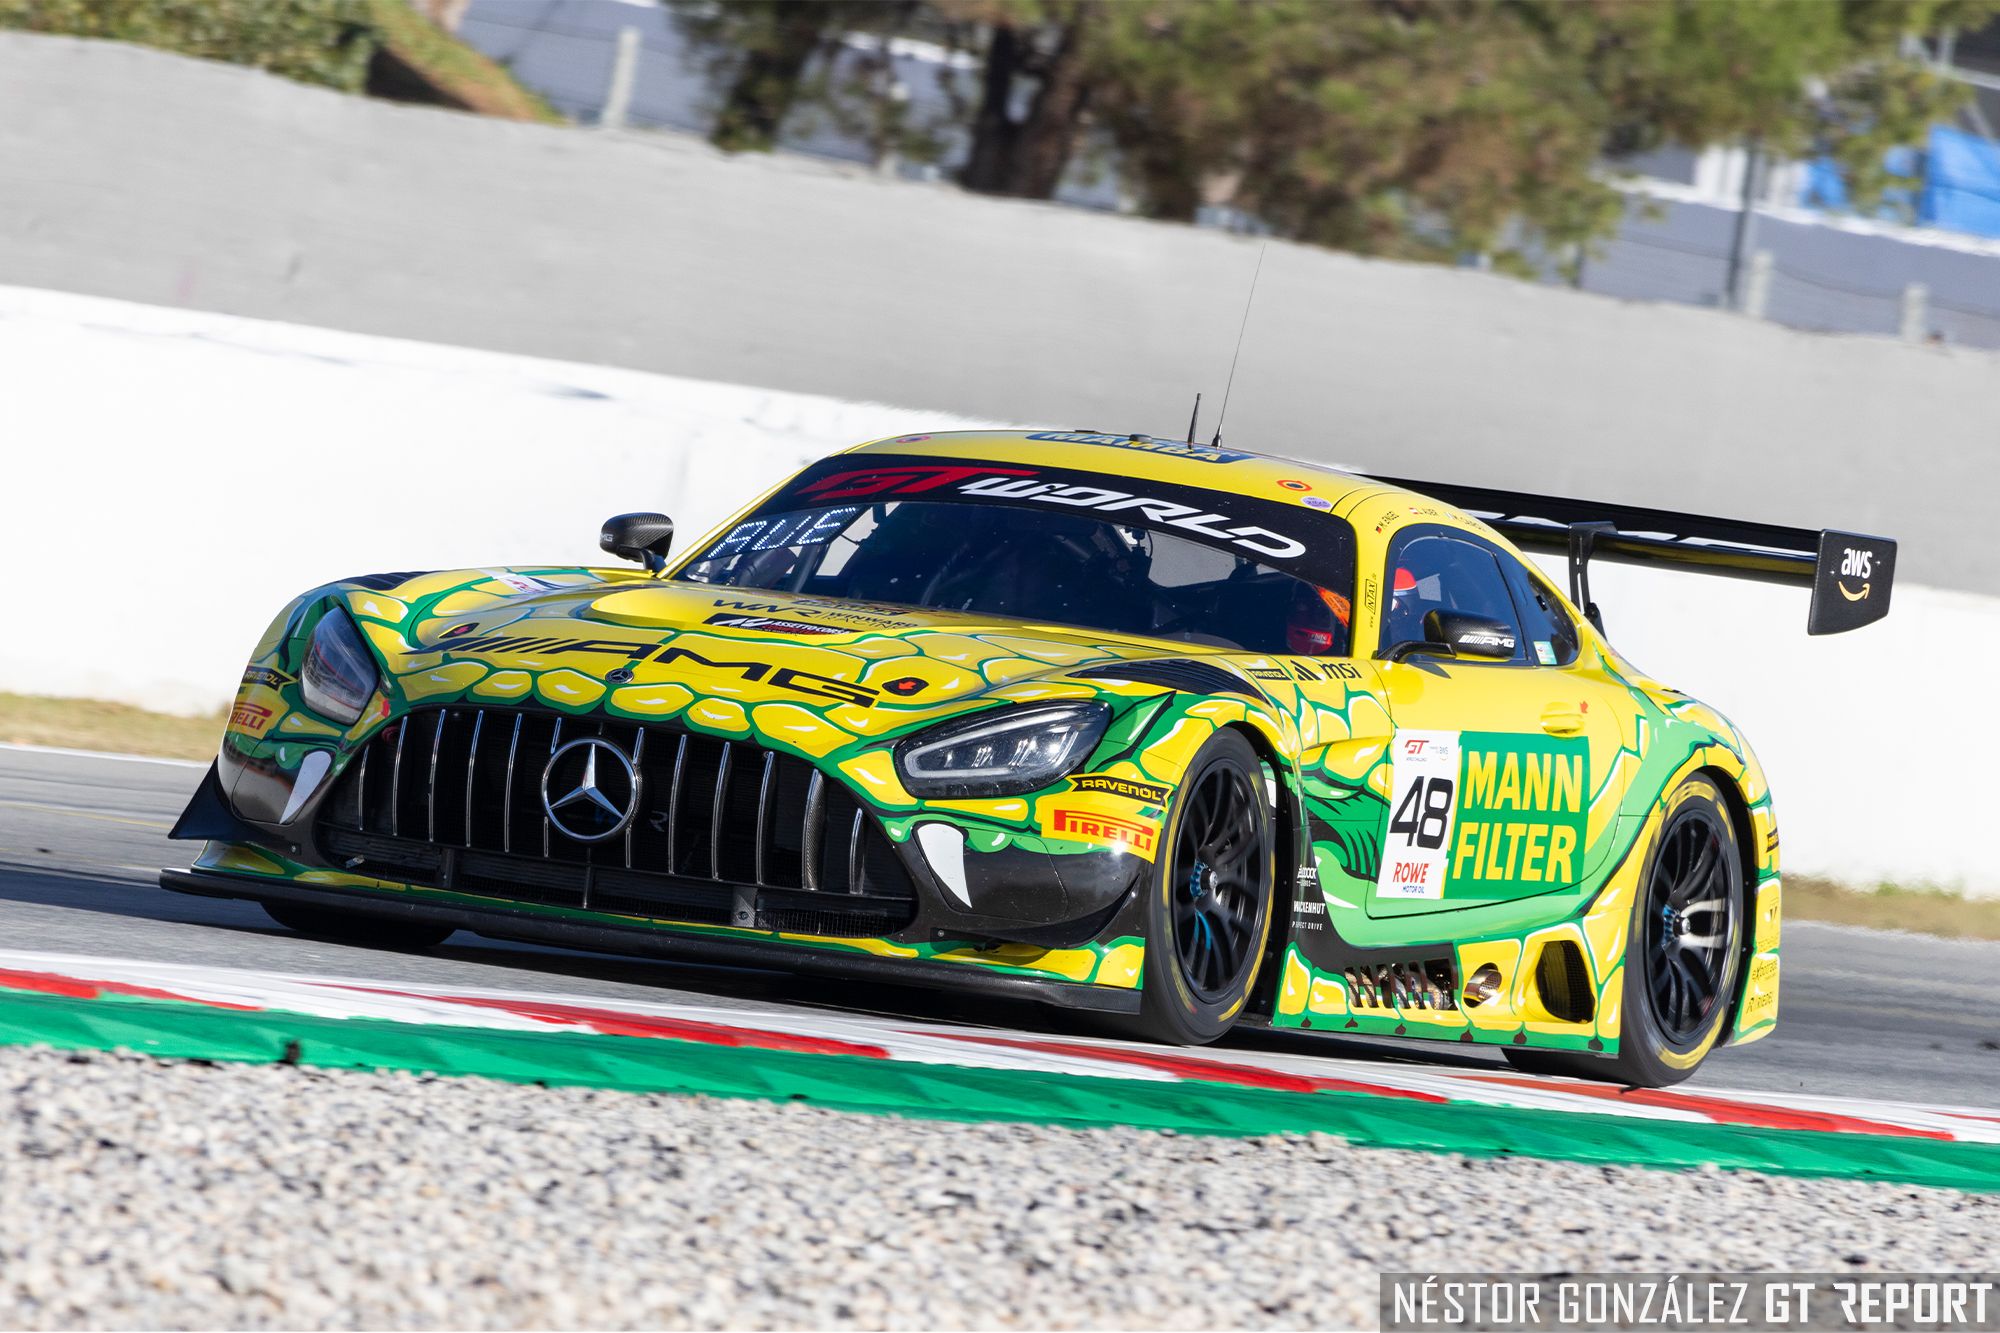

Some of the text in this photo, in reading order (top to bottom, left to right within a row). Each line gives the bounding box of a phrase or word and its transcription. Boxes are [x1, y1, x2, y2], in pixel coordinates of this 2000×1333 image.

[798, 465, 1307, 559] GT WORLD
[1840, 547, 1873, 579] aws
[828, 611, 920, 628] WINWARD
[1478, 636, 1515, 648] AMG
[535, 638, 882, 709] AMG
[1319, 663, 1362, 679] msi
[1463, 750, 1583, 813] MANN
[1053, 808, 1155, 852] PIRELLI
[1389, 775, 1454, 850] 48
[1392, 862, 1430, 884] ROWE
[1452, 821, 1577, 884] FILTER
